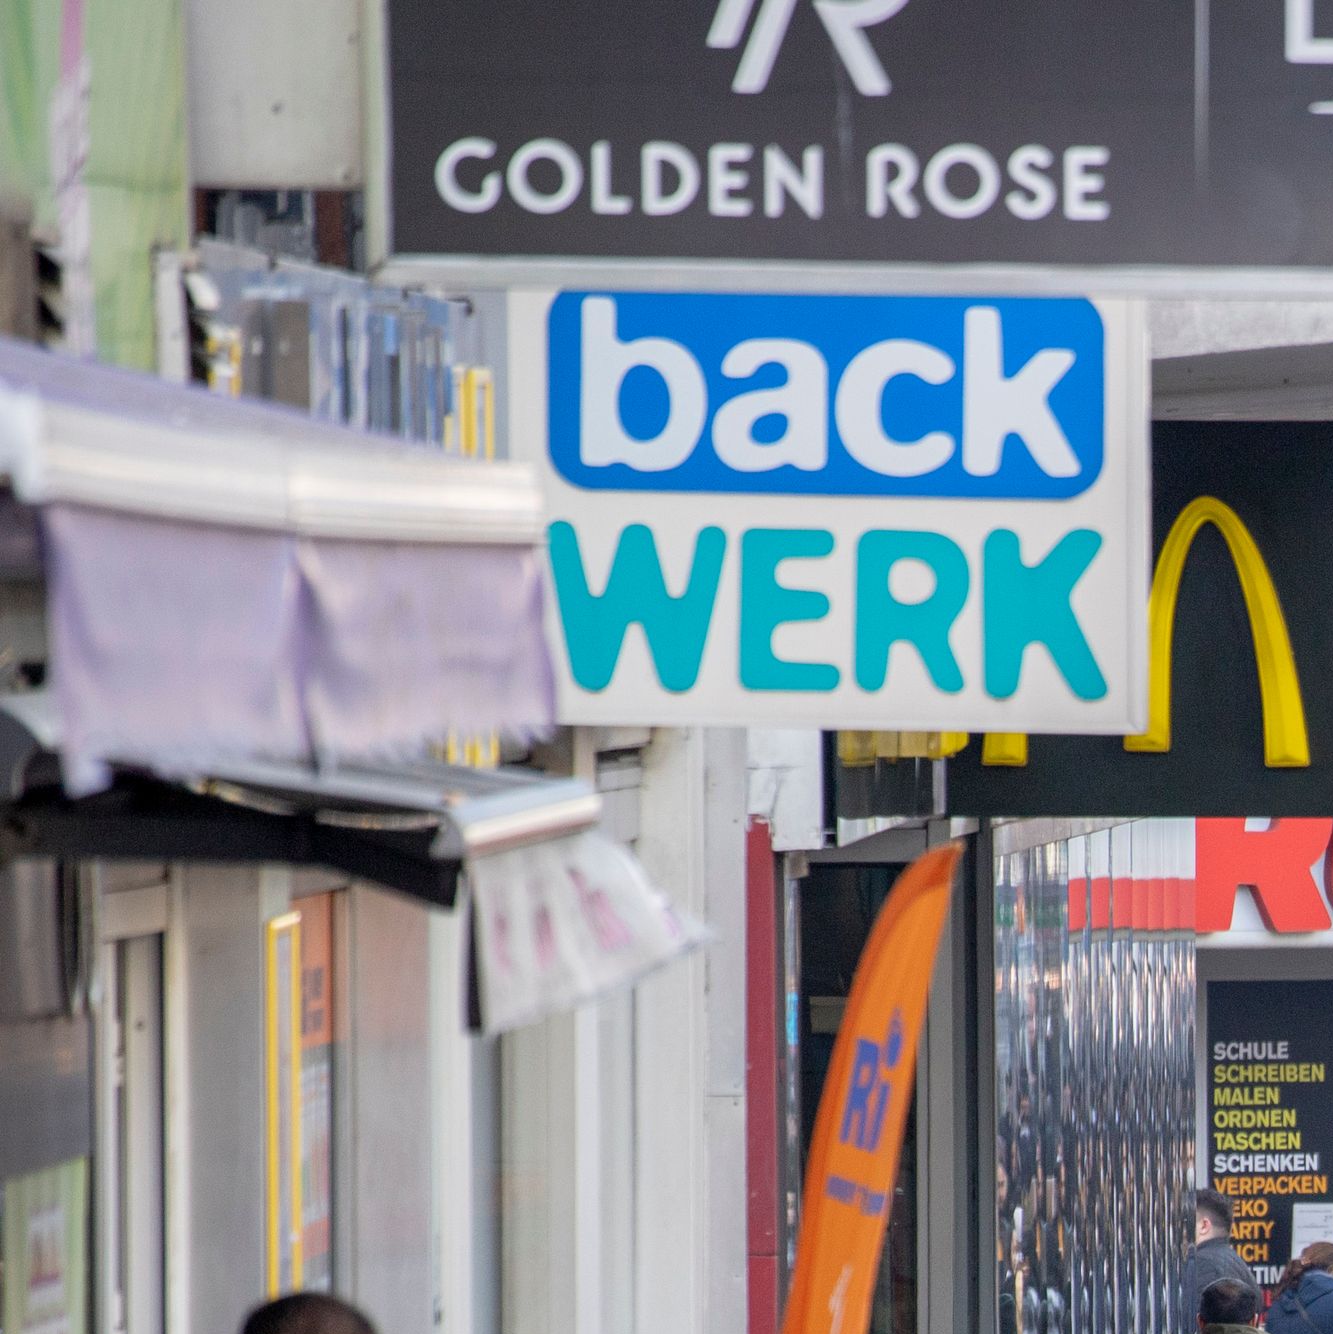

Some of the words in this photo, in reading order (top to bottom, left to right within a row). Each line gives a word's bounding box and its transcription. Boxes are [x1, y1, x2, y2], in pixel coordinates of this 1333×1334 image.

[434, 137, 824, 219] GOLDEN
[865, 142, 1110, 221] ROSE
[579, 295, 1083, 478] back
[548, 520, 1108, 701] WERK
[1213, 1041, 1289, 1061] SCHULE
[1213, 1063, 1325, 1083] SCHREIBEN
[1213, 1087, 1280, 1106] MALEN
[1213, 1109, 1297, 1128] ORDNEN
[1213, 1132, 1301, 1151] TASCHEN
[1213, 1153, 1319, 1173] SCHENKEN
[1214, 1175, 1328, 1196] VERPACKEN
[1232, 1199, 1269, 1217] EKO
[1230, 1221, 1274, 1239] ARTY
